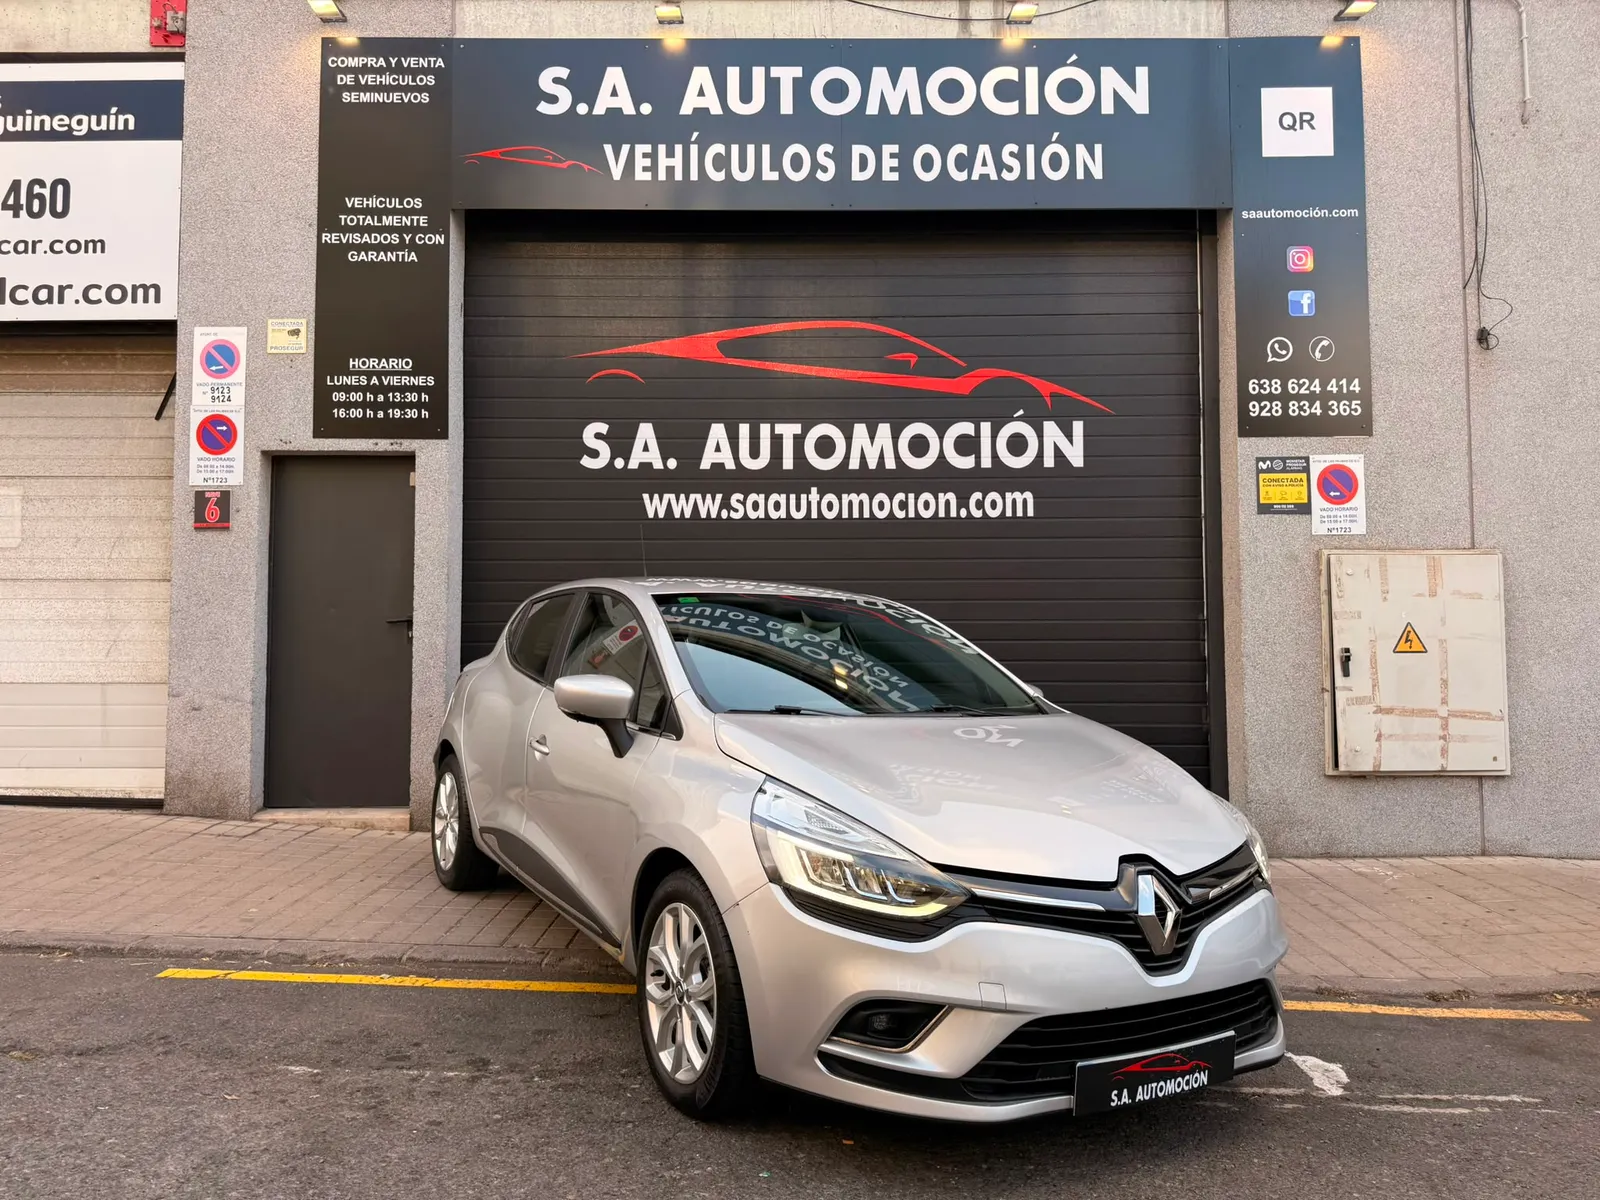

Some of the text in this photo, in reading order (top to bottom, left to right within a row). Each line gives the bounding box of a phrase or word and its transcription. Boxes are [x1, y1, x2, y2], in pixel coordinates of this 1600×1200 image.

[328, 57, 445, 68] COMPRA Y VENTA
[337, 72, 436, 86] DE VEHÍCULOS
[536, 54, 1150, 116] S.A. AUTOMOCIÓN
[342, 92, 430, 103] SEMINUEVOS
[0, 106, 135, 136] uineguín
[1278, 111, 1316, 132] QR
[603, 131, 1103, 182] VEHÍCULOS DE OCASIÓN
[1, 178, 70, 219] 460
[345, 195, 423, 209] VEHÍCULOS
[1242, 207, 1359, 219] saautomoción.com
[339, 215, 429, 226] TOTALMENTE
[322, 233, 445, 245] REVISADOS Y CON
[348, 249, 418, 262] GARANTÍA
[349, 358, 413, 370] HORARIO
[327, 375, 435, 386] LUNES A VIERNES
[1249, 378, 1361, 395] 638 624 414
[210, 386, 231, 394] 9123
[211, 394, 232, 403] 9124
[333, 392, 429, 402] 09:00 h a 13:30 h
[333, 408, 429, 419] 16:00 h a 19:30 h
[1249, 400, 1362, 417] 928 834 365
[580, 409, 1084, 470] S.A. AUTOMOCIÓN
[205, 497, 220, 523] 6
[1110, 1070, 1208, 1107] S.A. AUTOMOCIÓN
